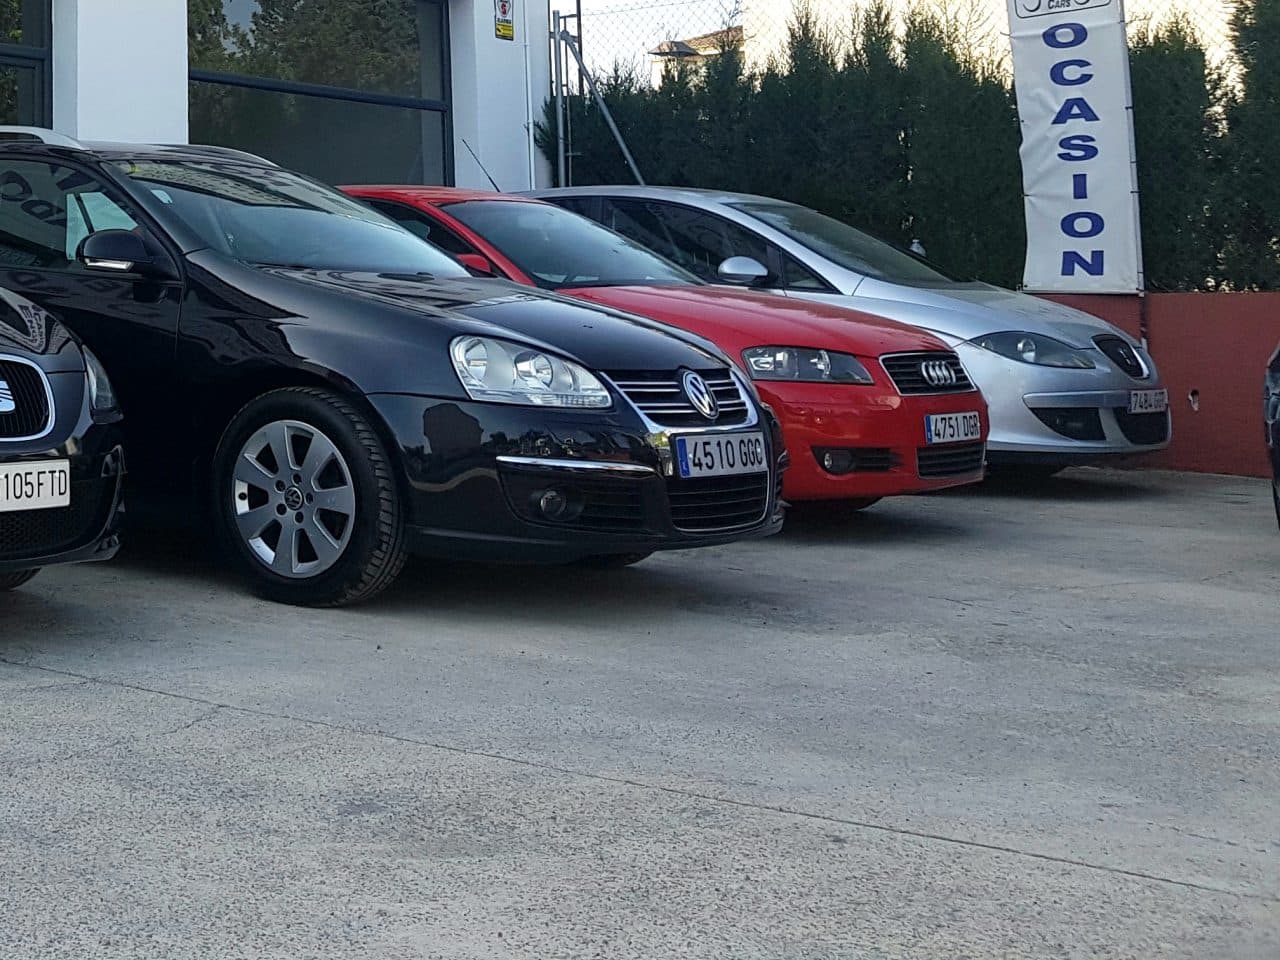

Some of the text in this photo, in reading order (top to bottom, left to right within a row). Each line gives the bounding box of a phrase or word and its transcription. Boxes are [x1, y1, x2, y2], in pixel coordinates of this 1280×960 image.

[1042, 22, 1105, 276] OCASION
[934, 416, 960, 439] 4751
[692, 440, 735, 471] 4510
